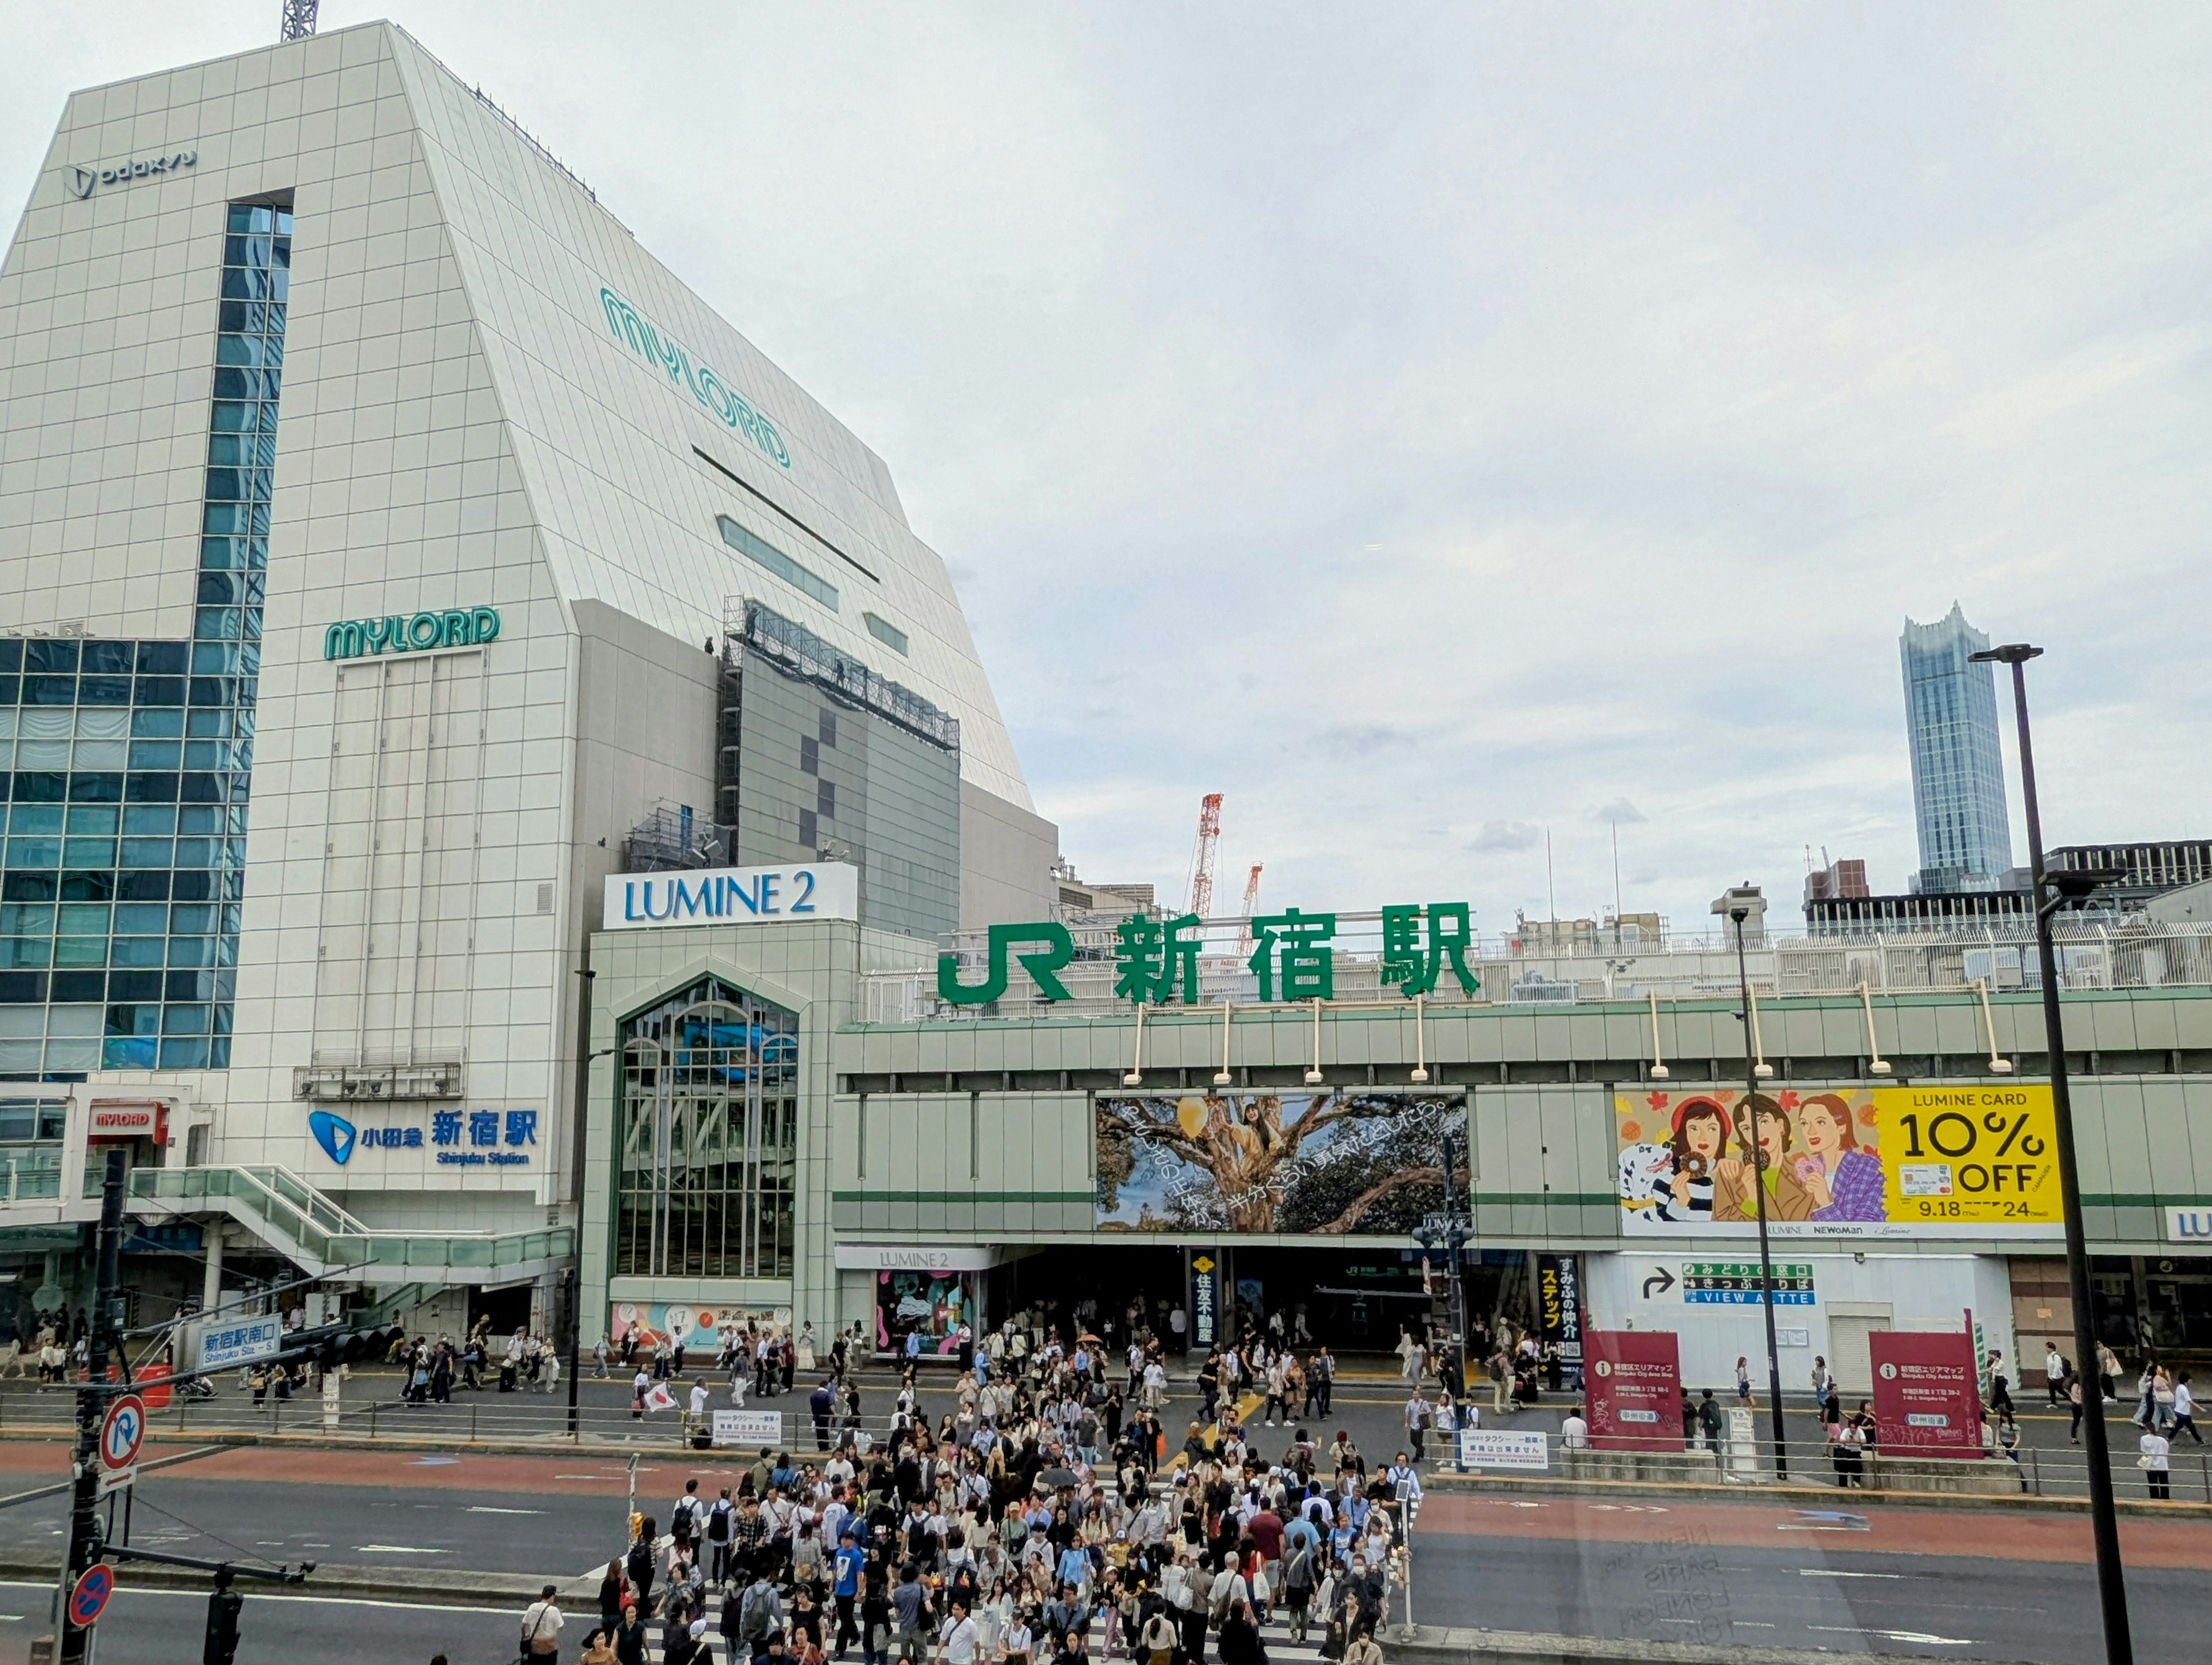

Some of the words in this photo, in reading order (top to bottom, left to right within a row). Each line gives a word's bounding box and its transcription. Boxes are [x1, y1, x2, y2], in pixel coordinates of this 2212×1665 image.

[101, 150, 197, 184] odakyu
[600, 287, 791, 469] MYLORD
[324, 606, 500, 660] MYLORD
[625, 873, 781, 921] LUMINE
[789, 870, 815, 912] 2
[1913, 1094, 1976, 1106] LUMINE
[1982, 1093, 2027, 1105] CARD
[95, 1112, 150, 1126] MYLORD
[361, 1128, 423, 1148] 小田急
[431, 1109, 537, 1146] 新宿駅
[1900, 1111, 2045, 1158] 10%
[436, 1152, 485, 1165] Shinjuku
[488, 1152, 530, 1165] Station
[1958, 1164, 2036, 1192] OFF
[1919, 1201, 1960, 1217] 9.18
[2003, 1201, 2030, 1217] 24
[880, 1252, 936, 1267] LUMINE
[940, 1253, 949, 1267] 2
[1702, 1278, 1809, 1290] きっぷりば
[1196, 1274, 1213, 1342] 住友不動産
[1542, 1269, 1560, 1328] ステップ
[1559, 1258, 1578, 1339] すみふの仲介
[1704, 1293, 1745, 1302] VIEW
[1755, 1294, 1809, 1304] ATTE
[205, 1323, 274, 1352] 新宿駅南口
[205, 1351, 239, 1363] Shinjuku
[1622, 1411, 1654, 1420] 甲州街道
[1910, 1415, 1944, 1425] 甲州街道
